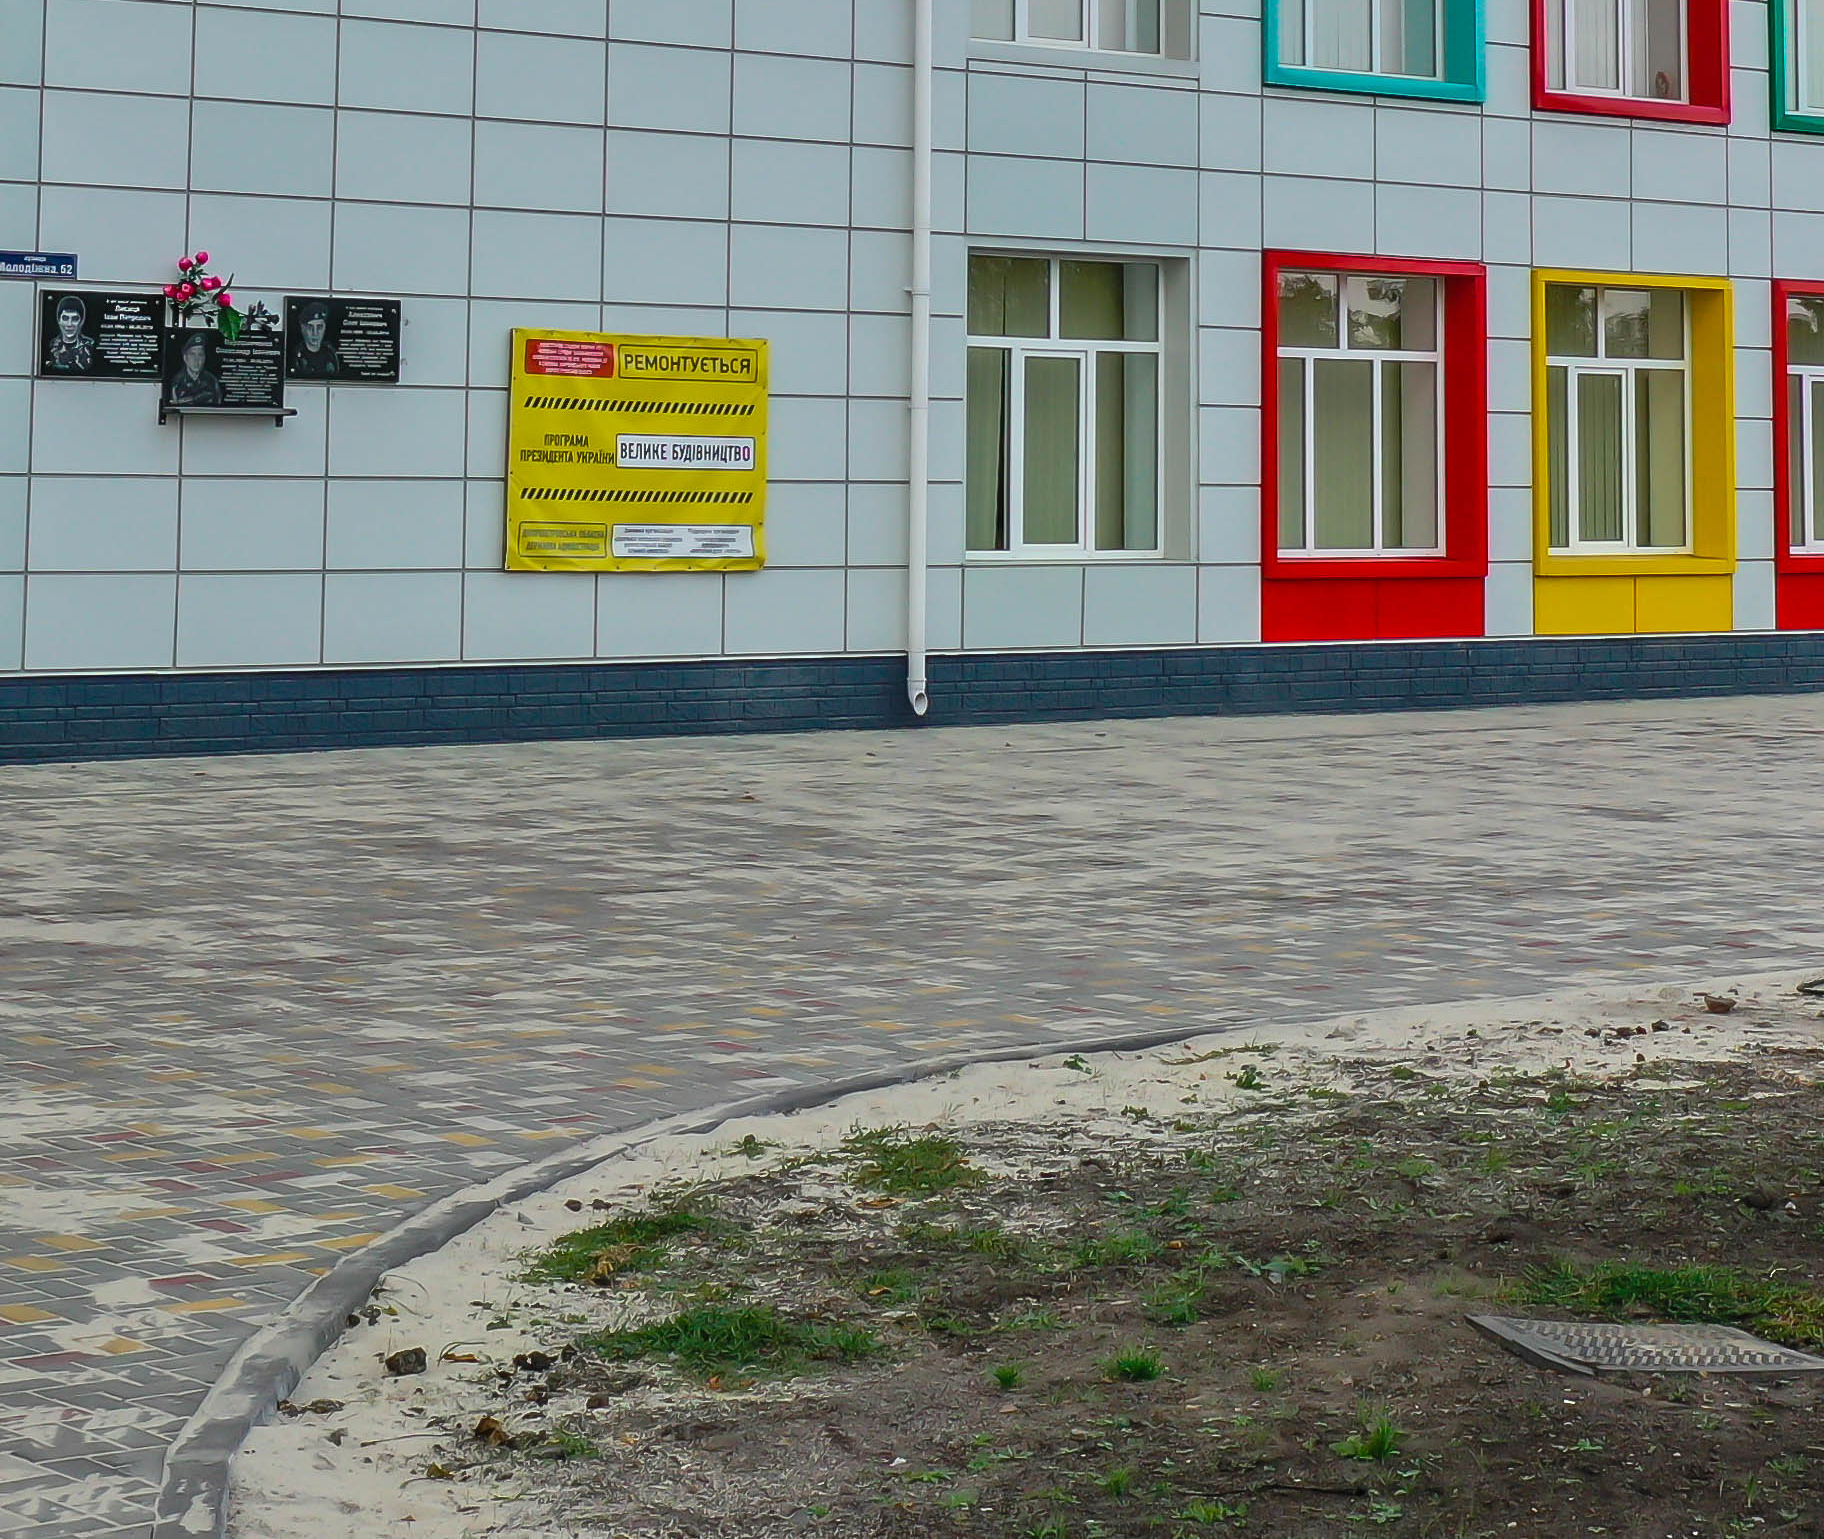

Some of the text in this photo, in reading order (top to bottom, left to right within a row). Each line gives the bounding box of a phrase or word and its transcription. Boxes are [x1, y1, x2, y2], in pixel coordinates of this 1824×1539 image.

[624, 354, 752, 374] РЕМОНТУЄТЬСЯ
[544, 434, 589, 447] ПРОГРАМА
[520, 449, 615, 464] ПРЕЗИДЕНТА УКРАЇНИ
[620, 442, 751, 463] ВЕЛИКЕ БУДІВНИЦТВО
